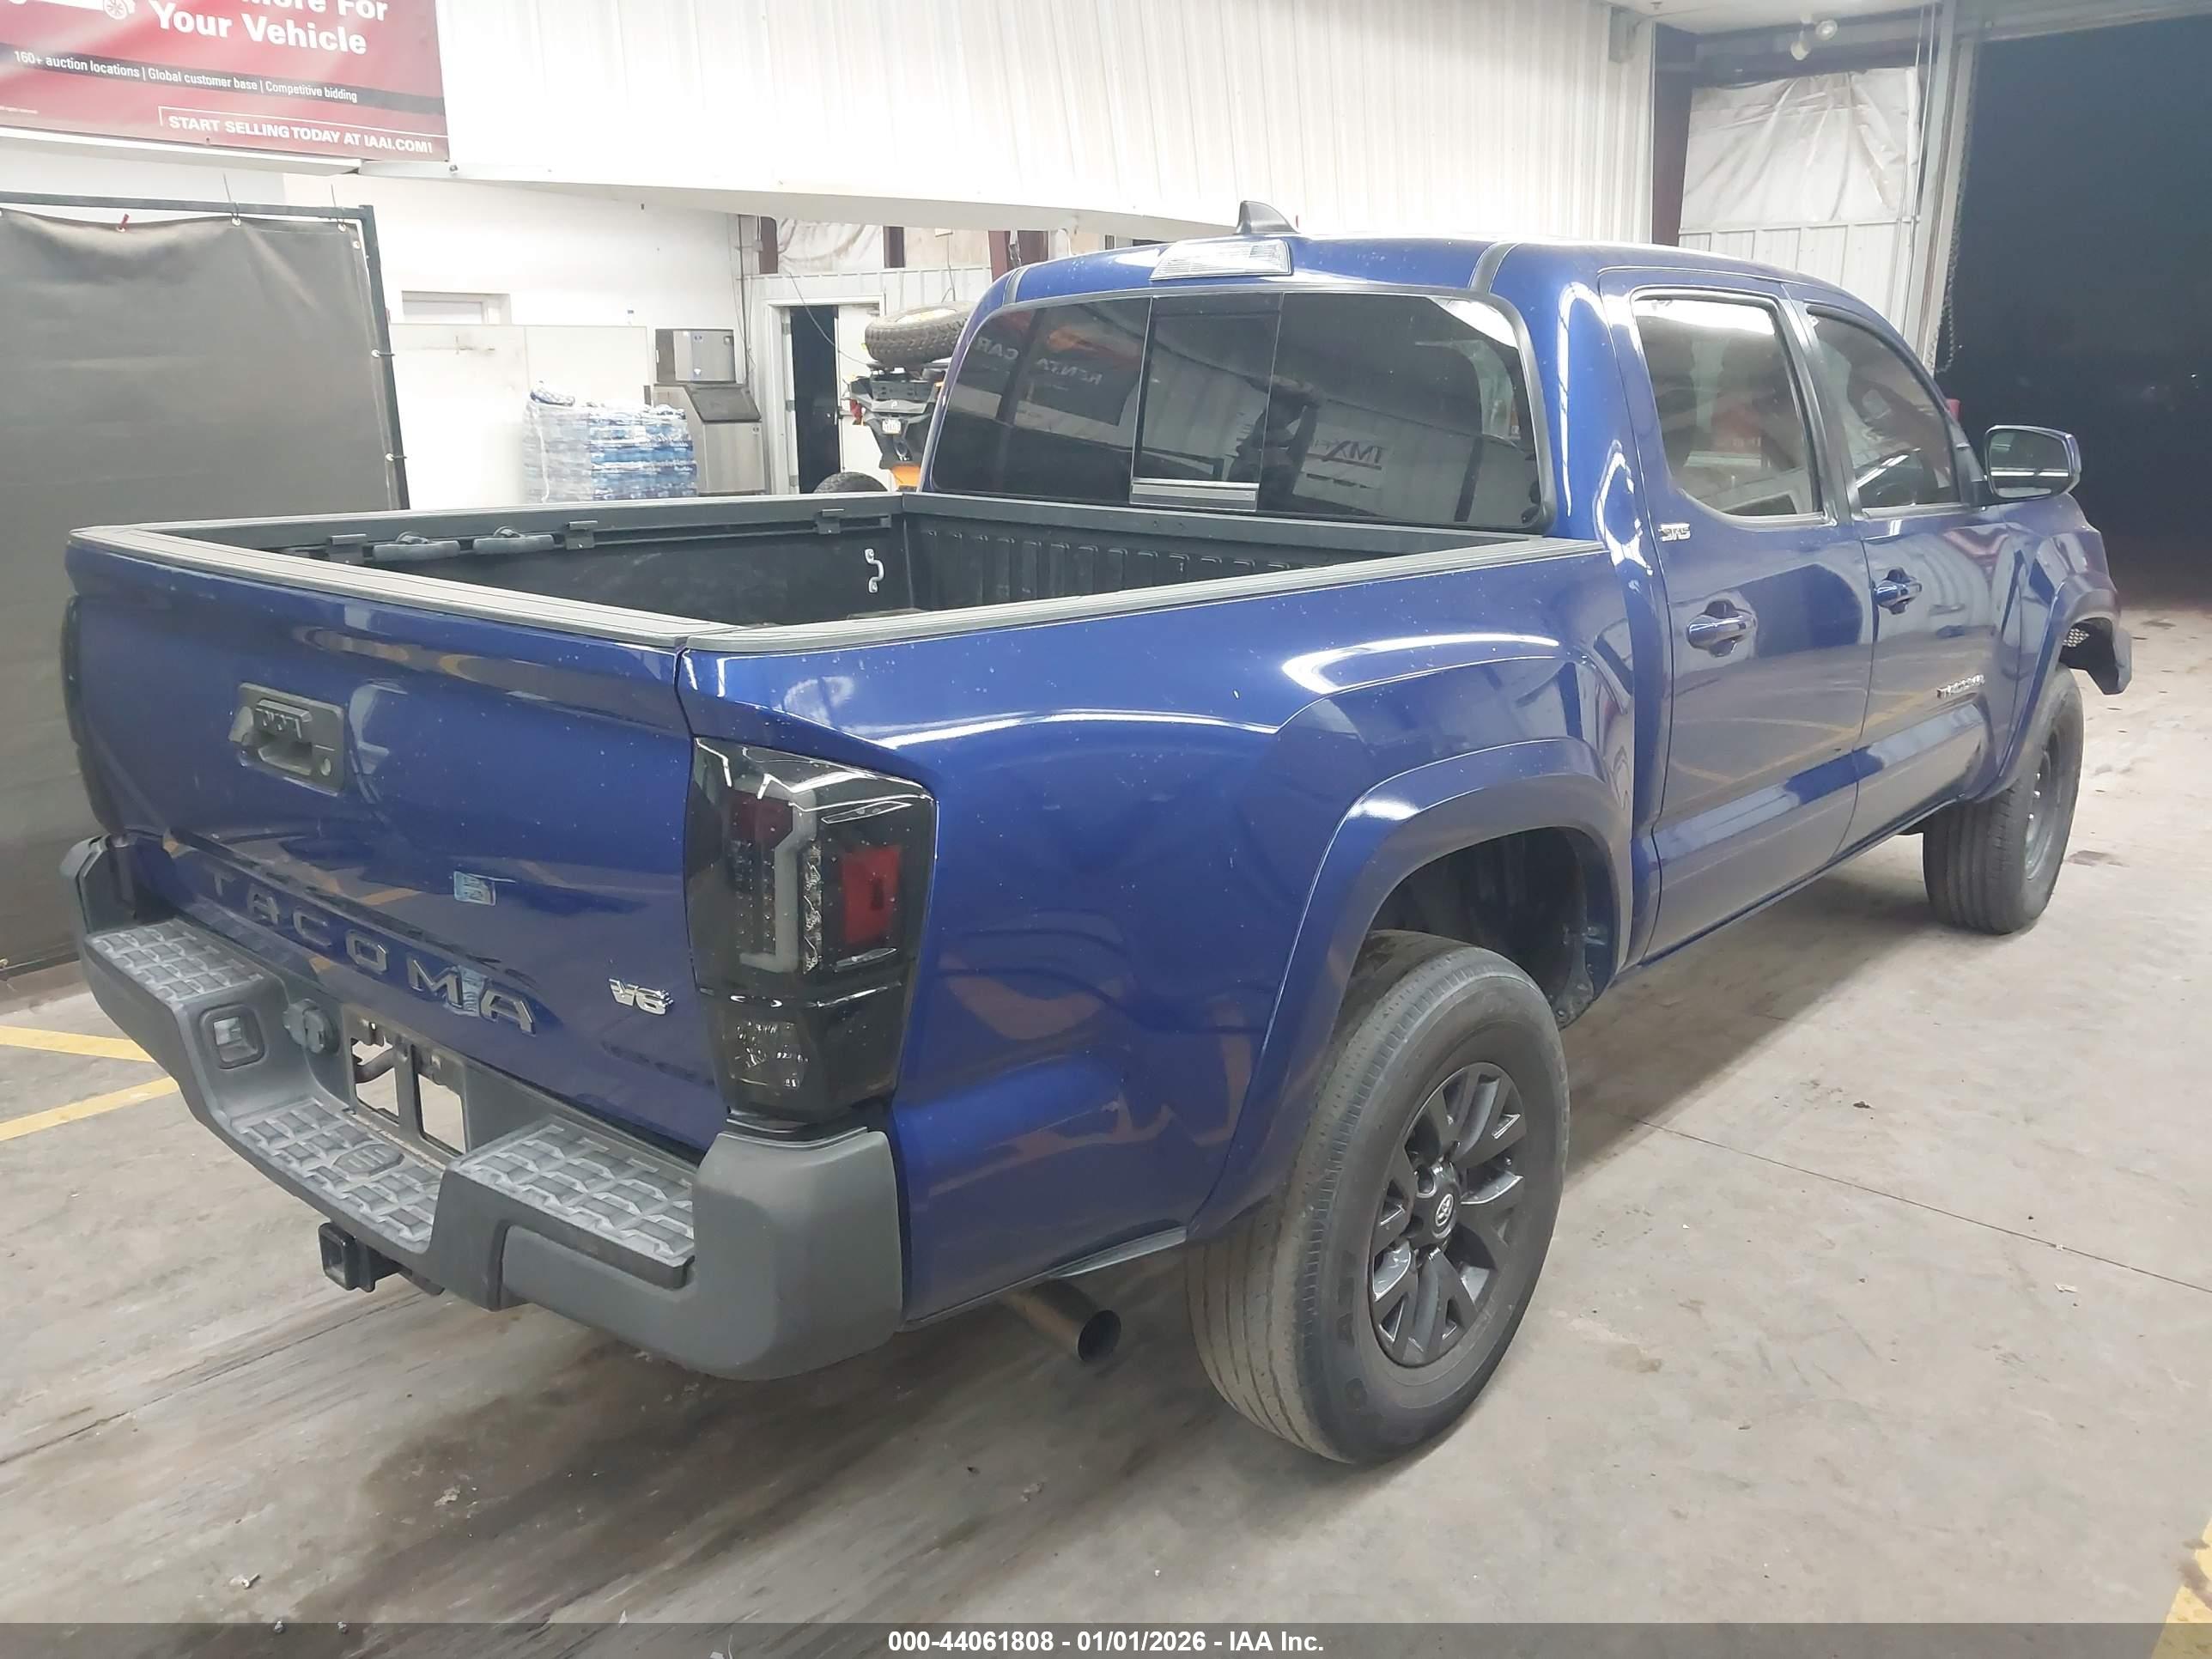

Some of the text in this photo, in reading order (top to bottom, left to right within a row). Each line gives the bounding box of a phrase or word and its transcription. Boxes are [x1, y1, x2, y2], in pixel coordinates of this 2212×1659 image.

[149, 1, 367, 55] Your Vehicle
[14, 51, 43, 64] 160+
[46, 56, 88, 71] auction
[90, 60, 140, 78] locations
[148, 68, 181, 83] Global
[184, 73, 231, 88] customer
[234, 76, 258, 91] base
[265, 80, 323, 98] Competitive
[324, 87, 358, 103] bidding
[168, 115, 433, 154] START SELLING TODAY AT IAAI.COM!
[211, 871, 536, 1039] TACOMA
[608, 978, 673, 1015] V6
